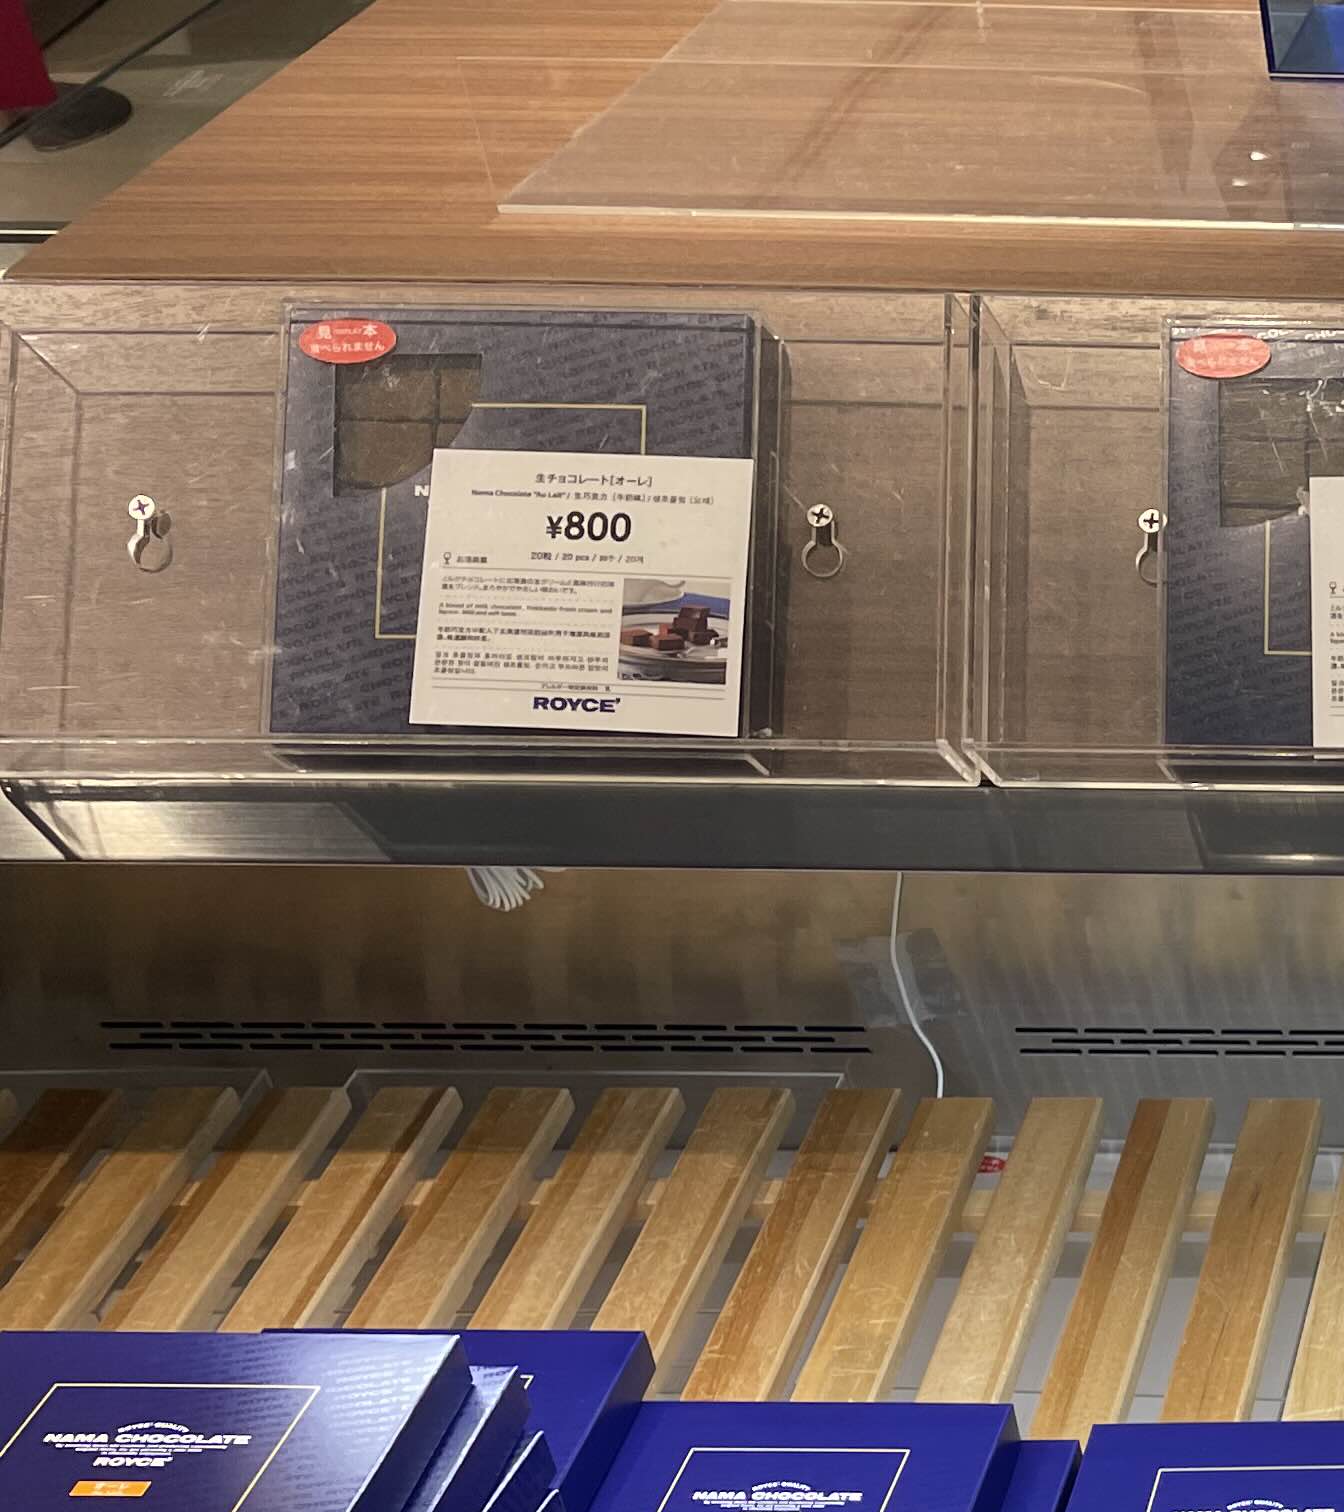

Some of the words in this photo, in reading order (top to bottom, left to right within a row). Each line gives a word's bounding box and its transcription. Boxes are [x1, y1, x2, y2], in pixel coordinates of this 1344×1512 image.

[536, 473, 652, 487] 生チョコレート[オーレ]
[546, 511, 632, 542] ¥800
[533, 696, 620, 712] ROYCE'
[43, 1434, 108, 1443] NAMA
[115, 1434, 252, 1445] CHOCOLATE
[93, 1456, 173, 1467] ROYCE'
[692, 1491, 746, 1500] NAMA
[752, 1492, 863, 1501] CHOCOLATE
